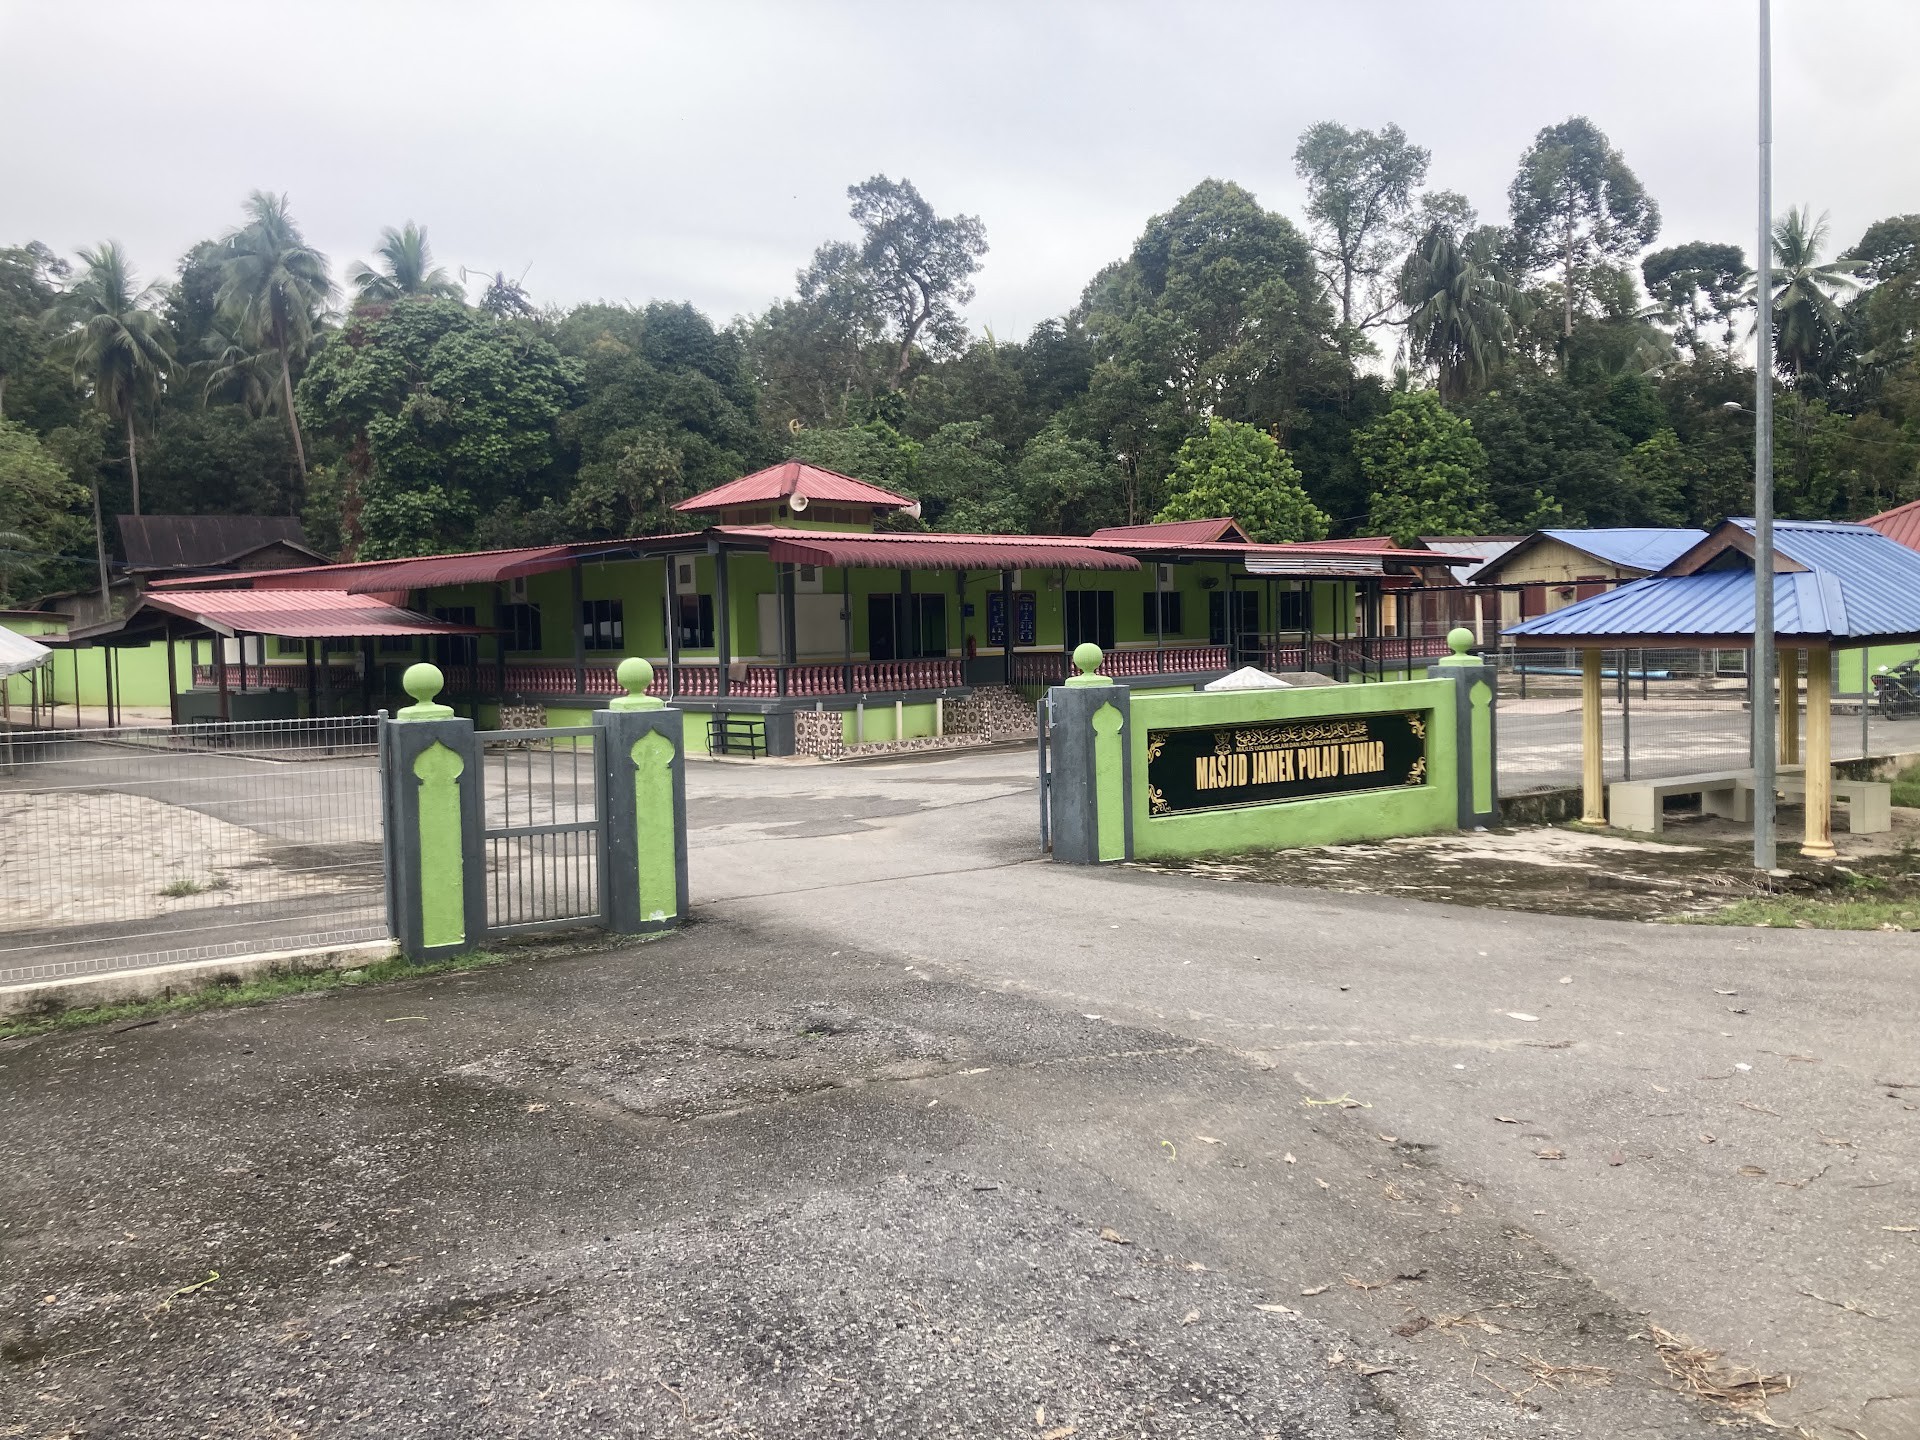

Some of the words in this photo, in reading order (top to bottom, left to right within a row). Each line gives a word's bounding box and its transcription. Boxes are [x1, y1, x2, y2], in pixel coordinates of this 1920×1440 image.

[1196, 753, 1249, 790] MASJID
[1252, 749, 1295, 785] JAMEK
[1298, 744, 1340, 780] PULAU
[1341, 741, 1385, 774] TAWAR
